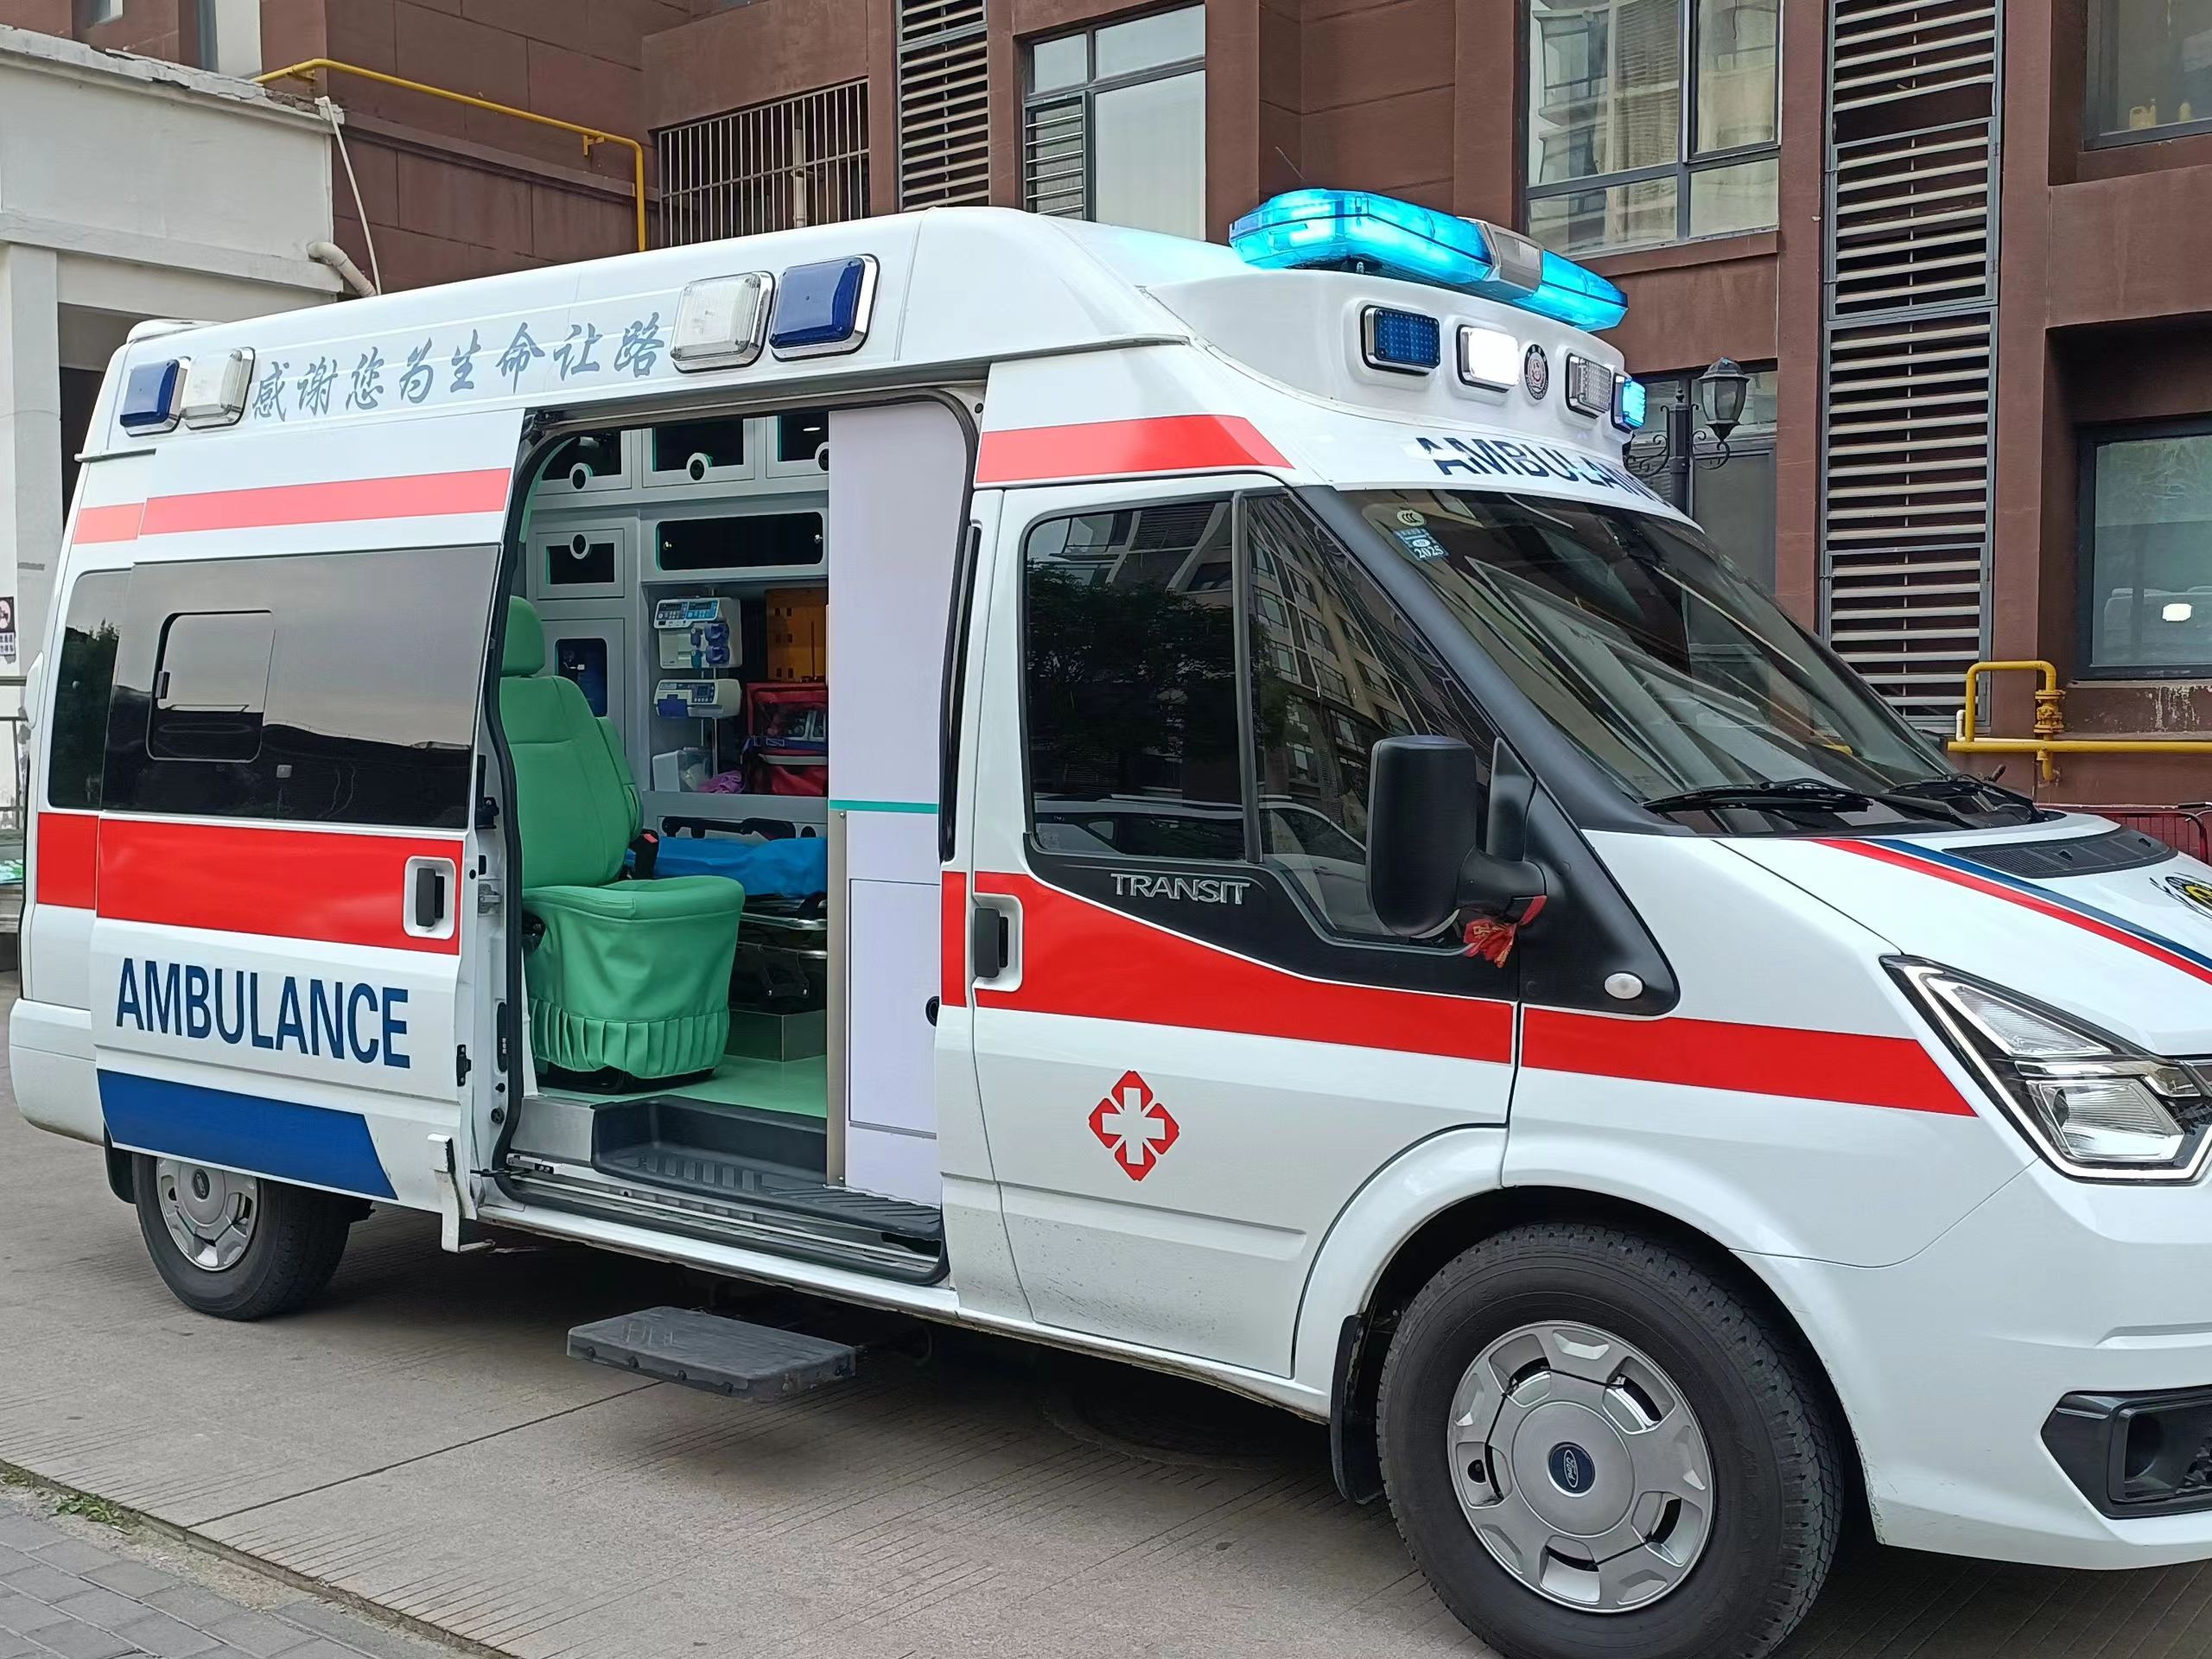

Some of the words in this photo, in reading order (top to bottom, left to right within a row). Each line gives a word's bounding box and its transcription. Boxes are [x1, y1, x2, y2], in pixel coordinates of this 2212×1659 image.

[251, 312, 664, 422] 感谢您为生命让路
[1414, 545, 1444, 558] 2025
[1110, 873, 1250, 905] TRANSIT
[116, 957, 410, 1069] AMBULANCE
